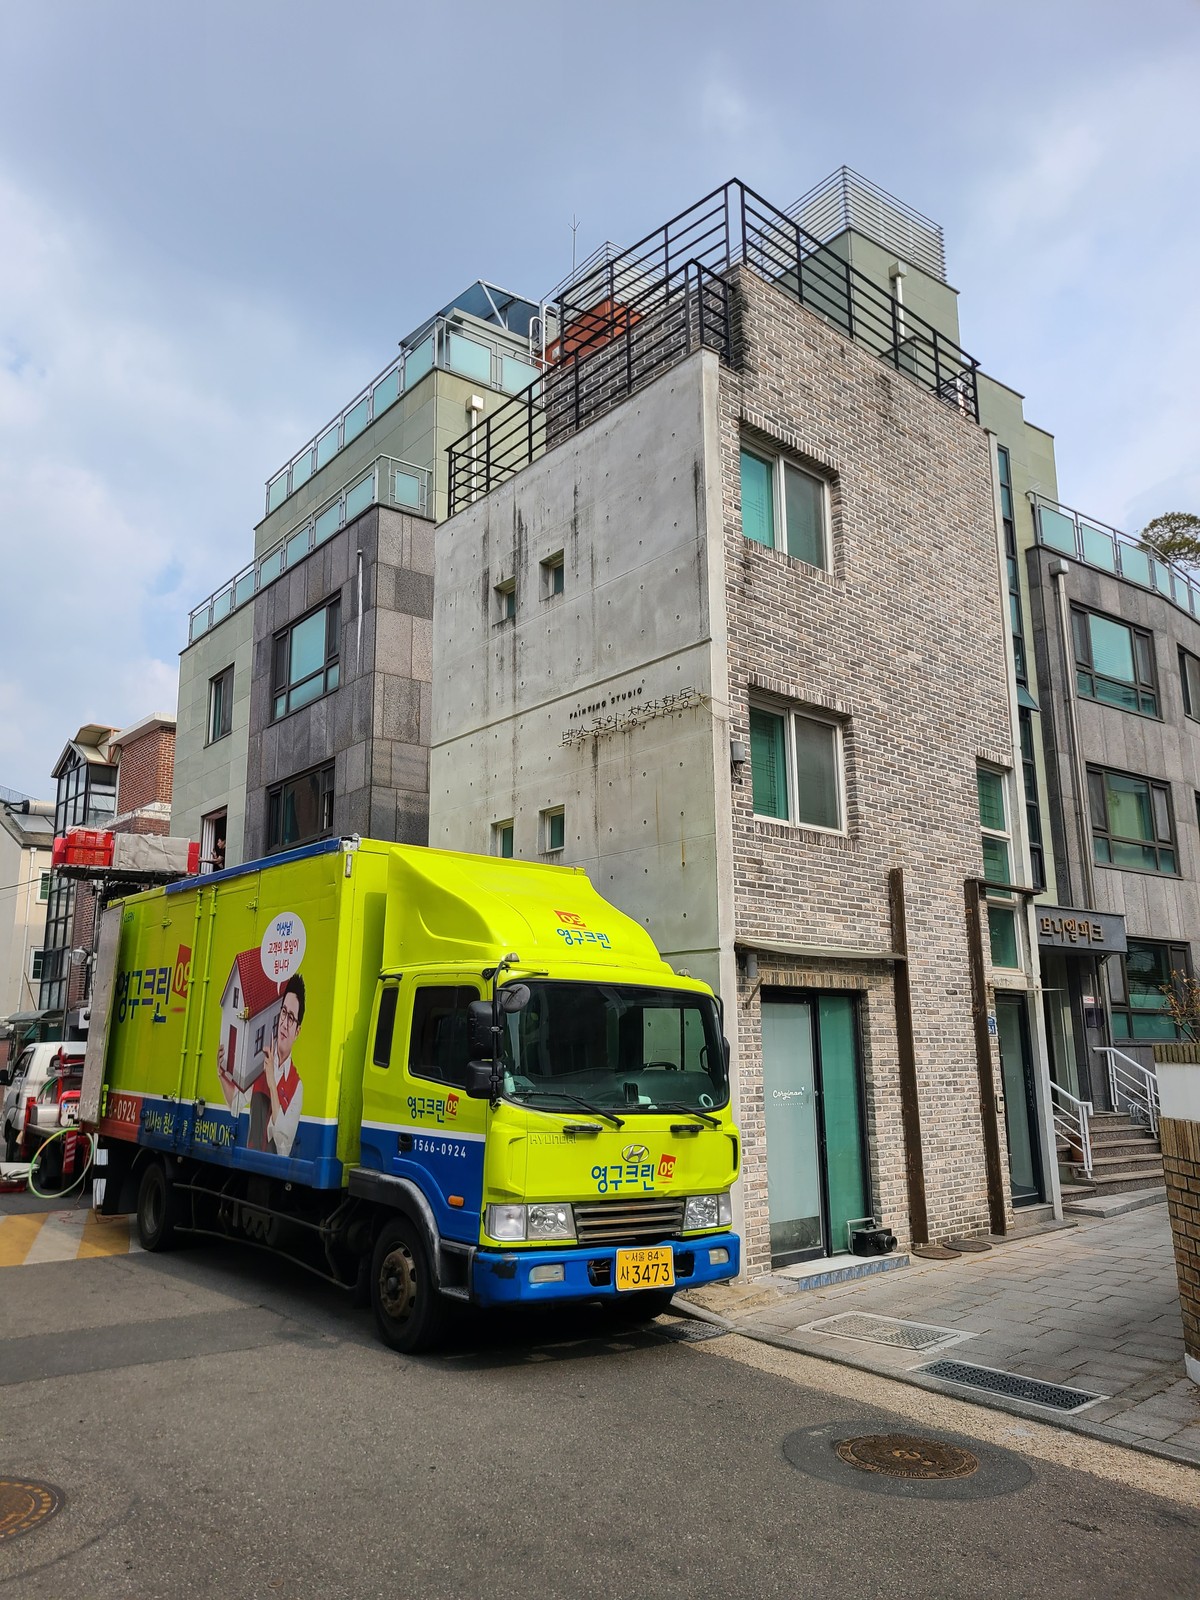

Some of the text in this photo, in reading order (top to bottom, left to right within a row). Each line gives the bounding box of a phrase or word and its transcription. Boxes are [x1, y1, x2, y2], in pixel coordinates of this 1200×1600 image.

[568, 687, 643, 720] PAINTING STUDIO
[276, 920, 294, 936] 이삿날!
[560, 914, 583, 925] 09
[267, 939, 300, 956] 고객의 휴일이
[556, 928, 611, 949] 영구크린
[274, 958, 290, 975] 됩니다
[117, 962, 191, 1023] 영구크린 09
[407, 1095, 459, 1123] 영구크린 09
[195, 1118, 217, 1141] 한번에
[530, 1134, 577, 1145] HYUNDAI
[413, 1138, 467, 1158] 1566-0924
[591, 1160, 675, 1193] 영구크린 09
[630, 1250, 660, 1263] 서울 84
[620, 1262, 671, 1285] 사 3473
